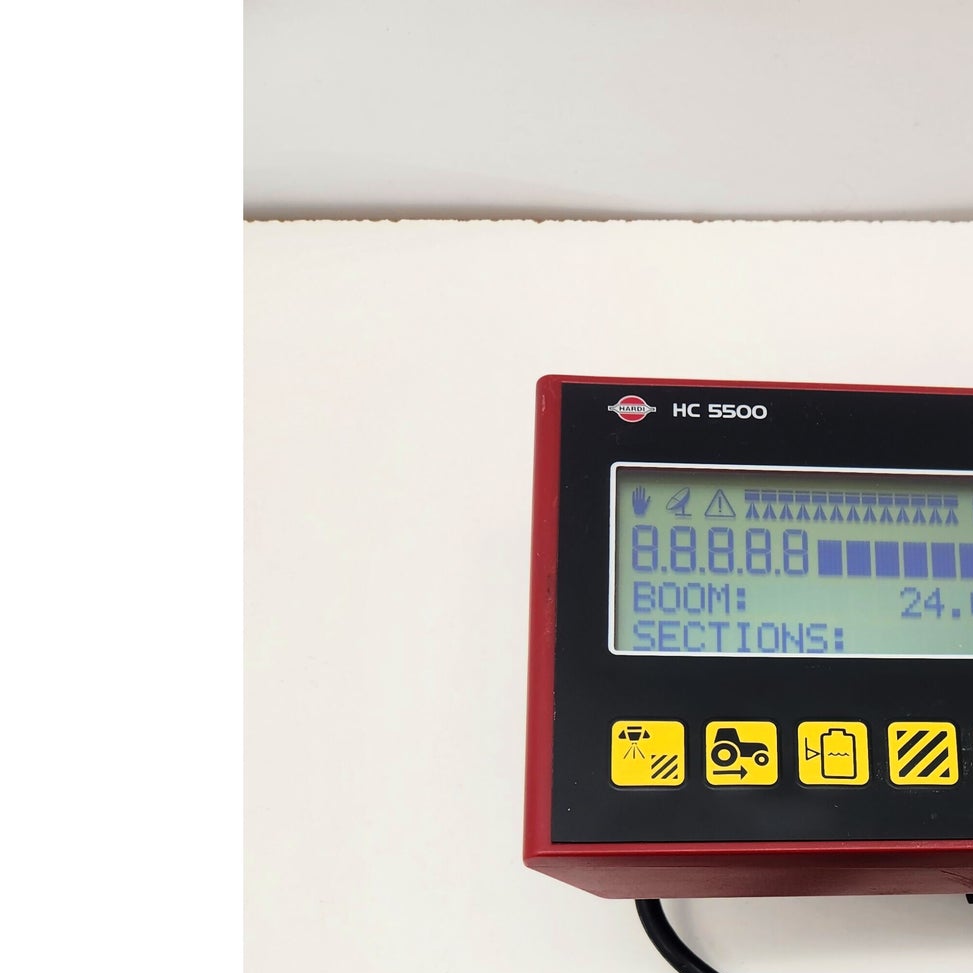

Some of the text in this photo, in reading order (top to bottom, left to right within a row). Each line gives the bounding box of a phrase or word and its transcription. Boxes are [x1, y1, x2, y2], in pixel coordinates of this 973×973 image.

[672, 402, 768, 420] HC 5500
[632, 581, 747, 614] BOOM:
[632, 619, 845, 653] SECTIONS:
